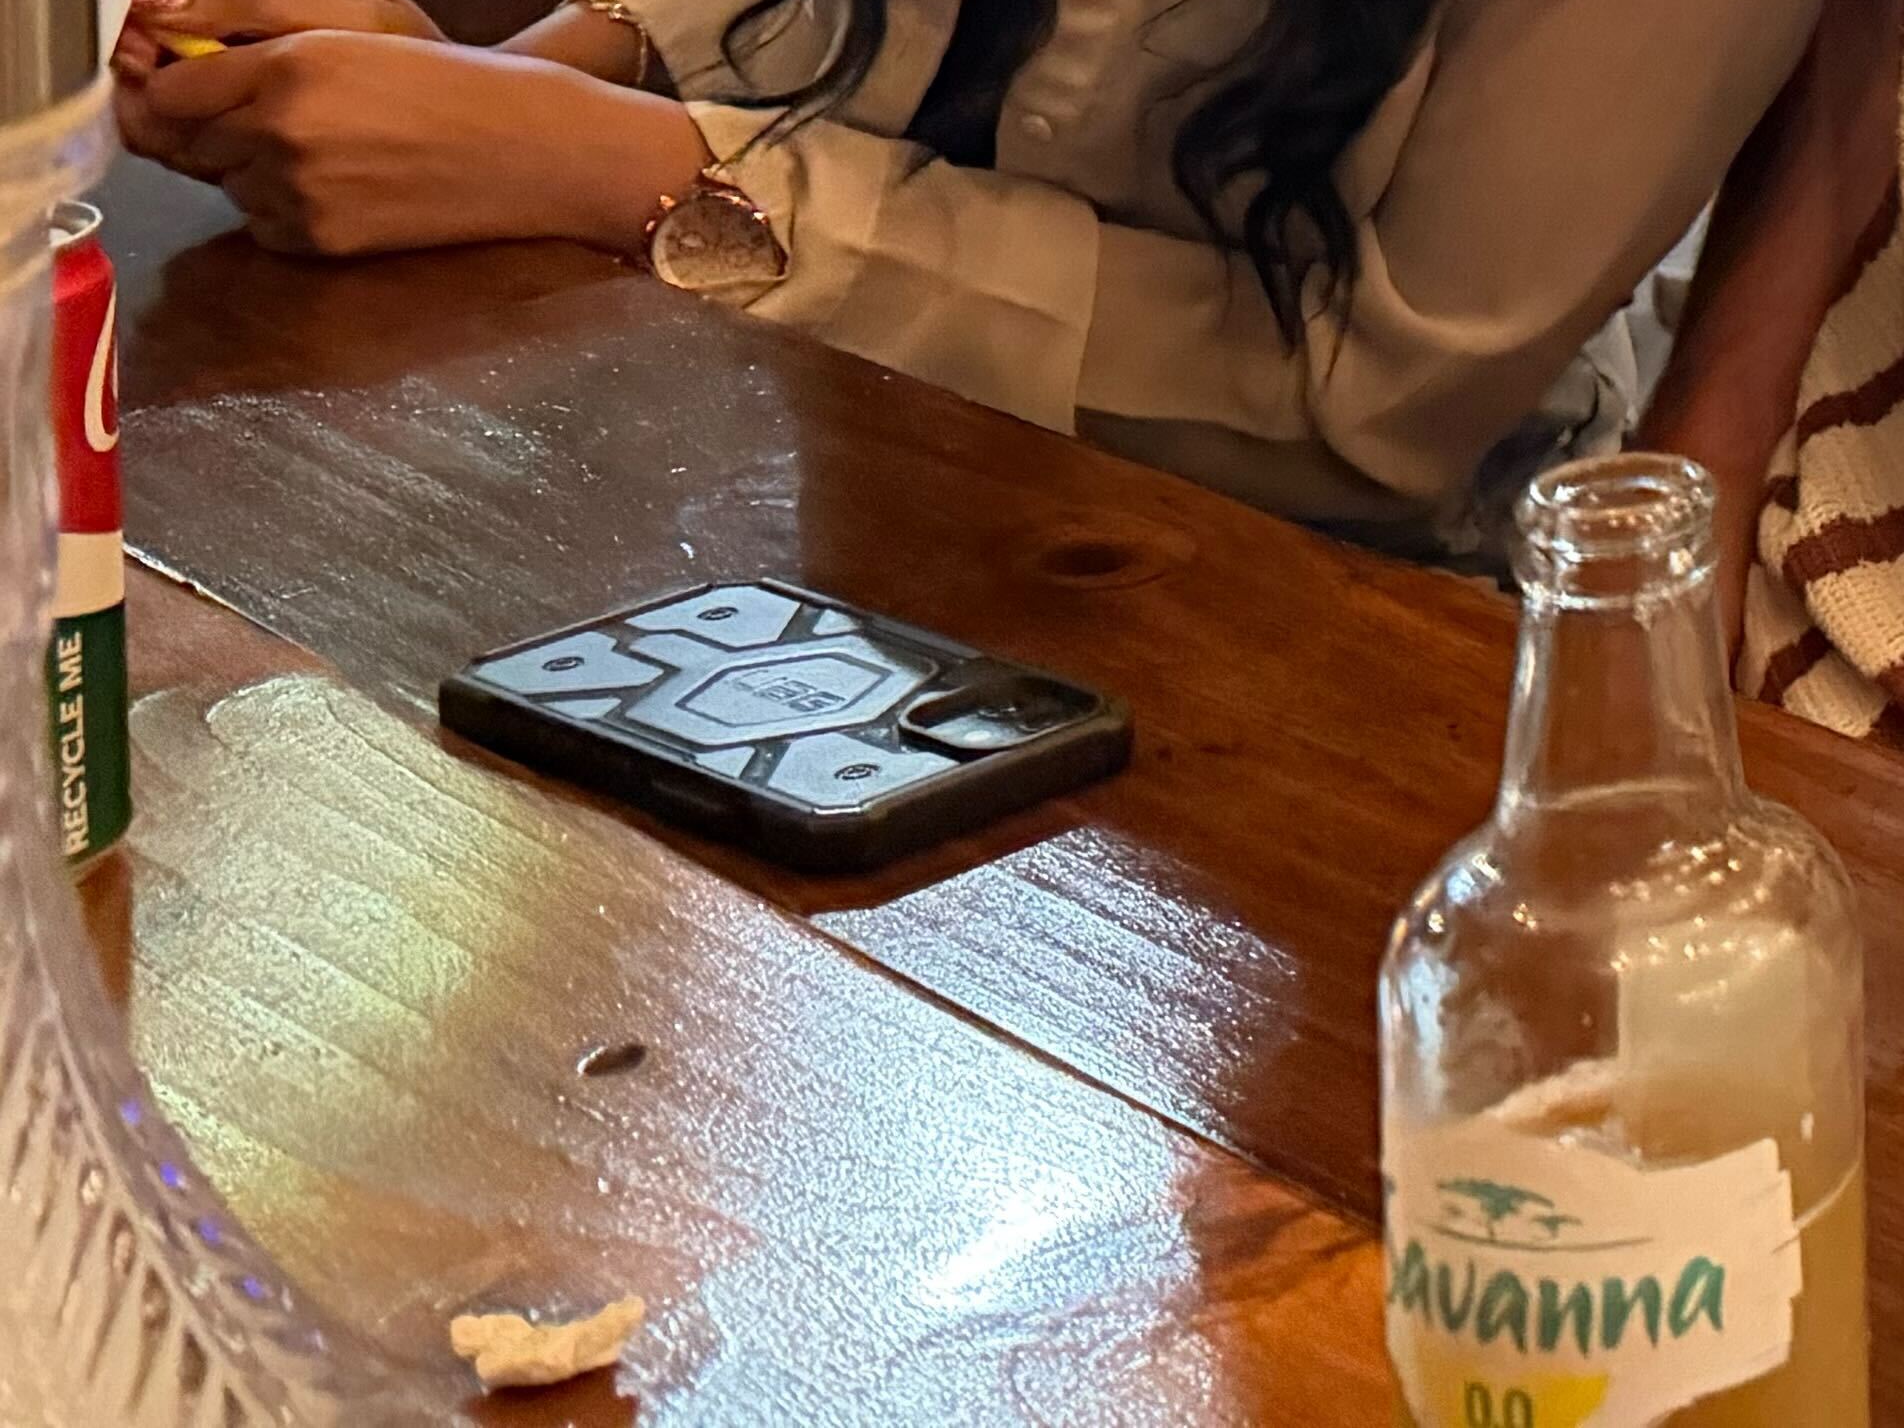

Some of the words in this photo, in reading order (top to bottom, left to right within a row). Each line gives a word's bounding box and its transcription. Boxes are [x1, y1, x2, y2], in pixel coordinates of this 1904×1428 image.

[57, 632, 83, 692] ME
[60, 694, 89, 856] RECYCLE
[1389, 1240, 1725, 1359] avanna
